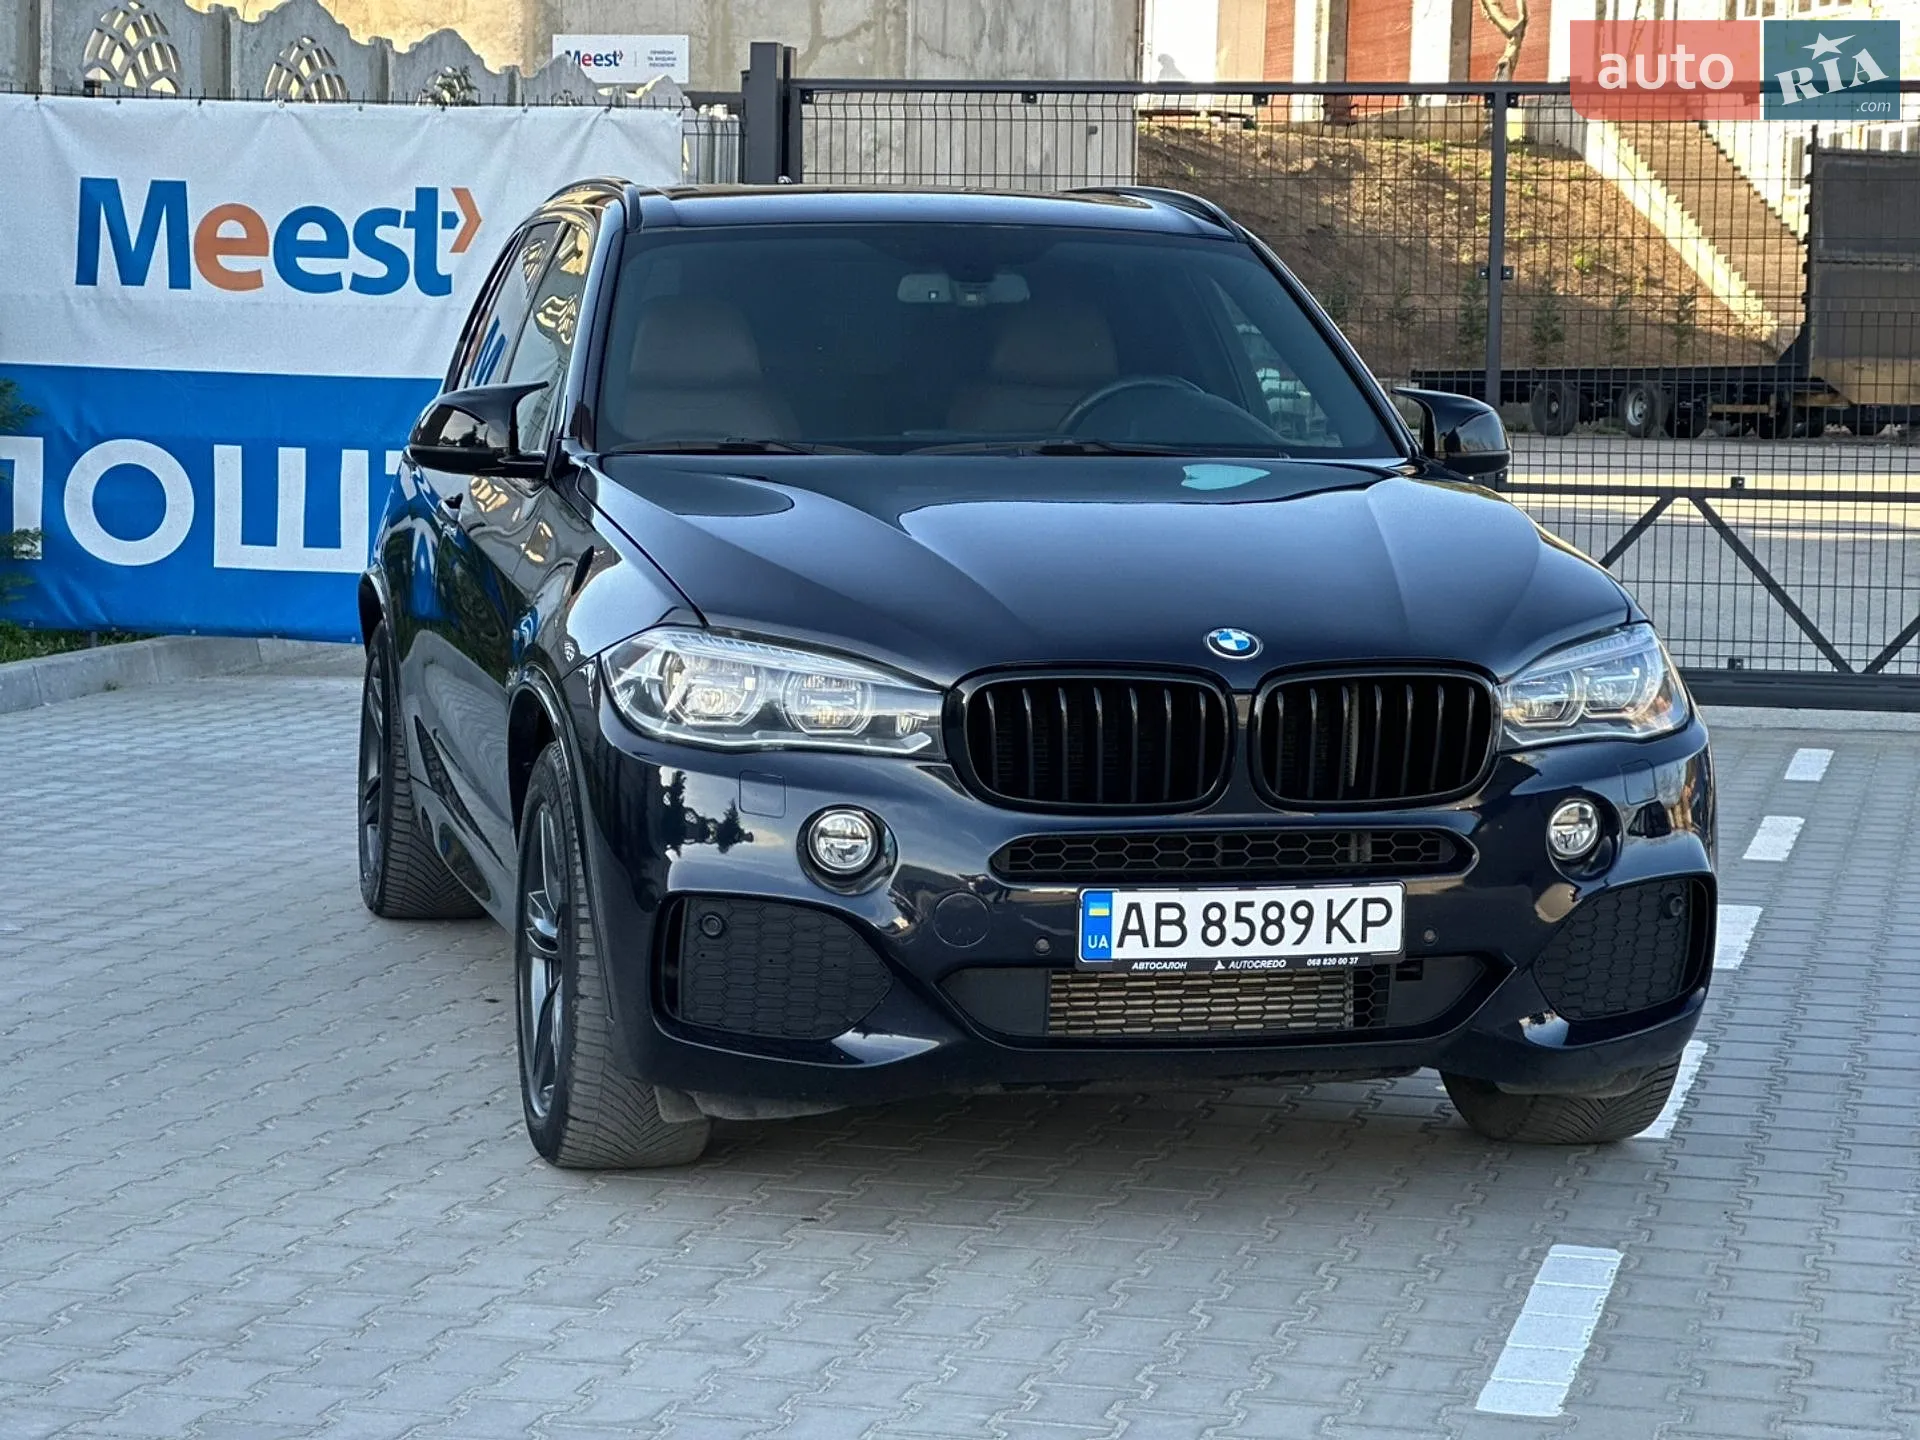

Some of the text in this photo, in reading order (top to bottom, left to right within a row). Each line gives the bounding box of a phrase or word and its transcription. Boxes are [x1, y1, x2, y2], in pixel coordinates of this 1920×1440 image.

[75, 177, 453, 297] Meest
[1116, 897, 1393, 948] AB 8589 KP
[1088, 935, 1109, 949] UA
[1131, 961, 1188, 971] АВТОСАЛОН
[1228, 959, 1287, 970] AUTOCREDO
[1348, 956, 1359, 965] 37
